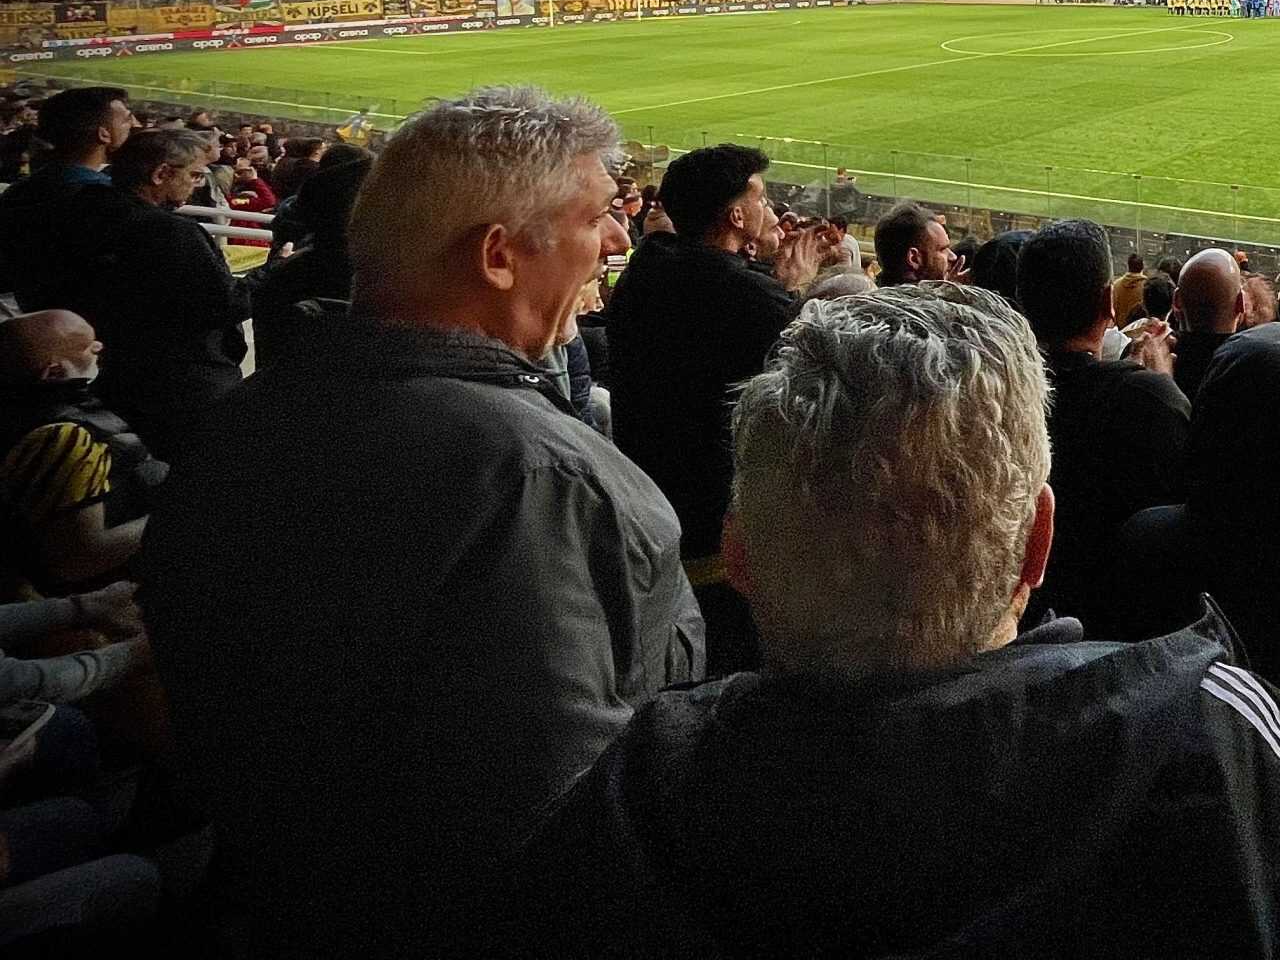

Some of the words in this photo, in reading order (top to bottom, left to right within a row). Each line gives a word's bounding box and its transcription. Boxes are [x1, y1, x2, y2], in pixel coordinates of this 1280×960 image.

[294, 31, 321, 41] opap
[339, 29, 369, 37] arena
[192, 39, 224, 49] opap
[244, 35, 277, 44] arena
[10, 51, 54, 62] arena
[76, 46, 112, 58] opap
[135, 43, 173, 52] arena
